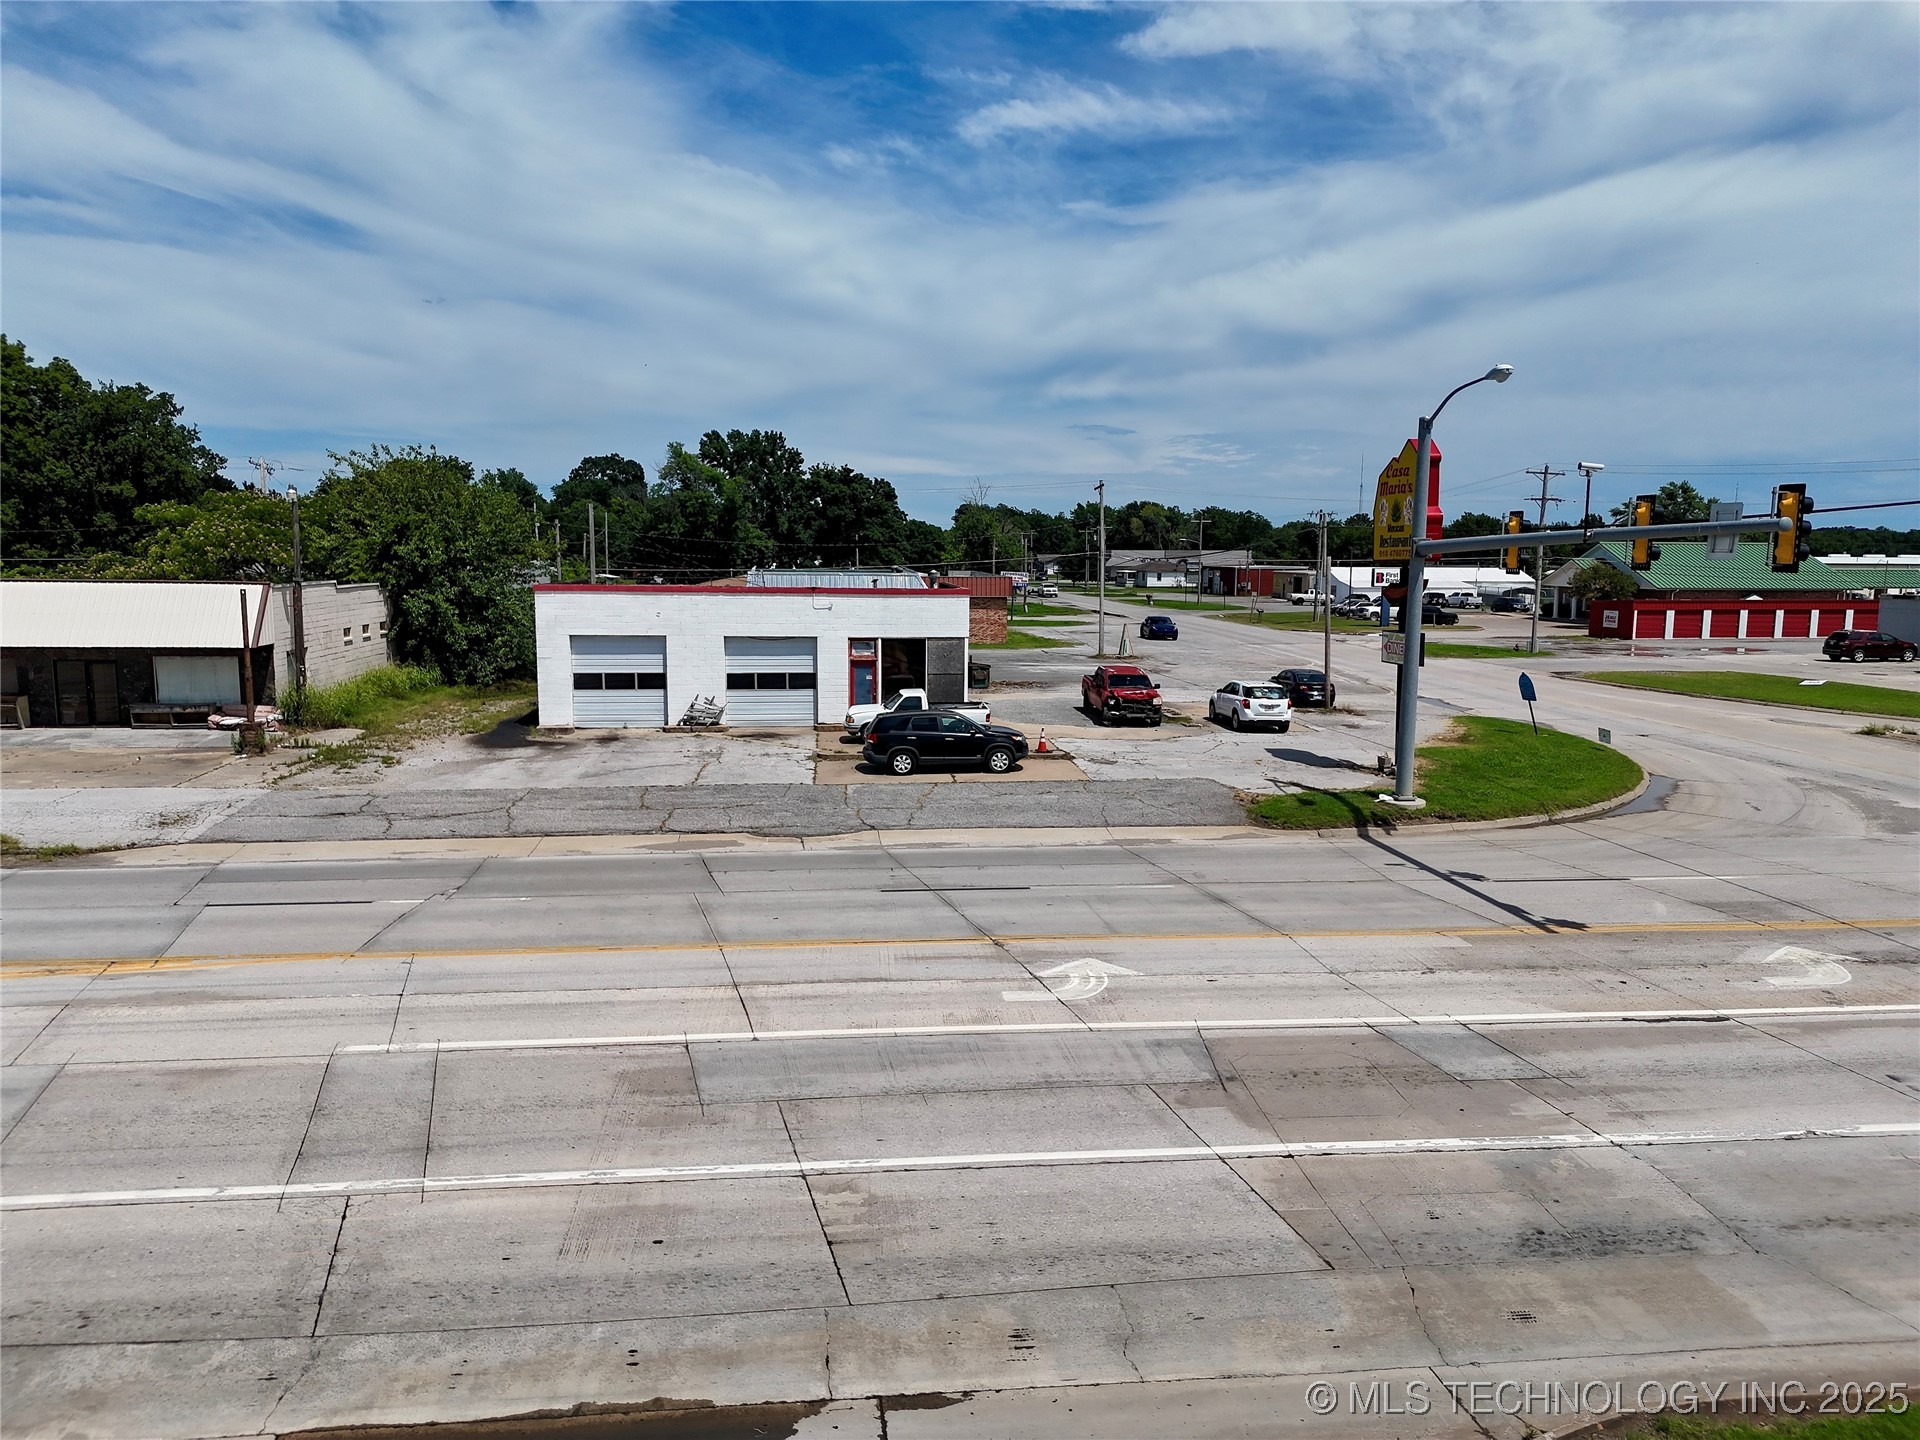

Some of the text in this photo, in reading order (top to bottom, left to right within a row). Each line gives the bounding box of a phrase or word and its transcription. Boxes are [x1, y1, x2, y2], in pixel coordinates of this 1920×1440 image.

[1386, 464, 1410, 478] Casa
[1379, 479, 1413, 497] Maria's
[1379, 534, 1412, 548] Restaurant
